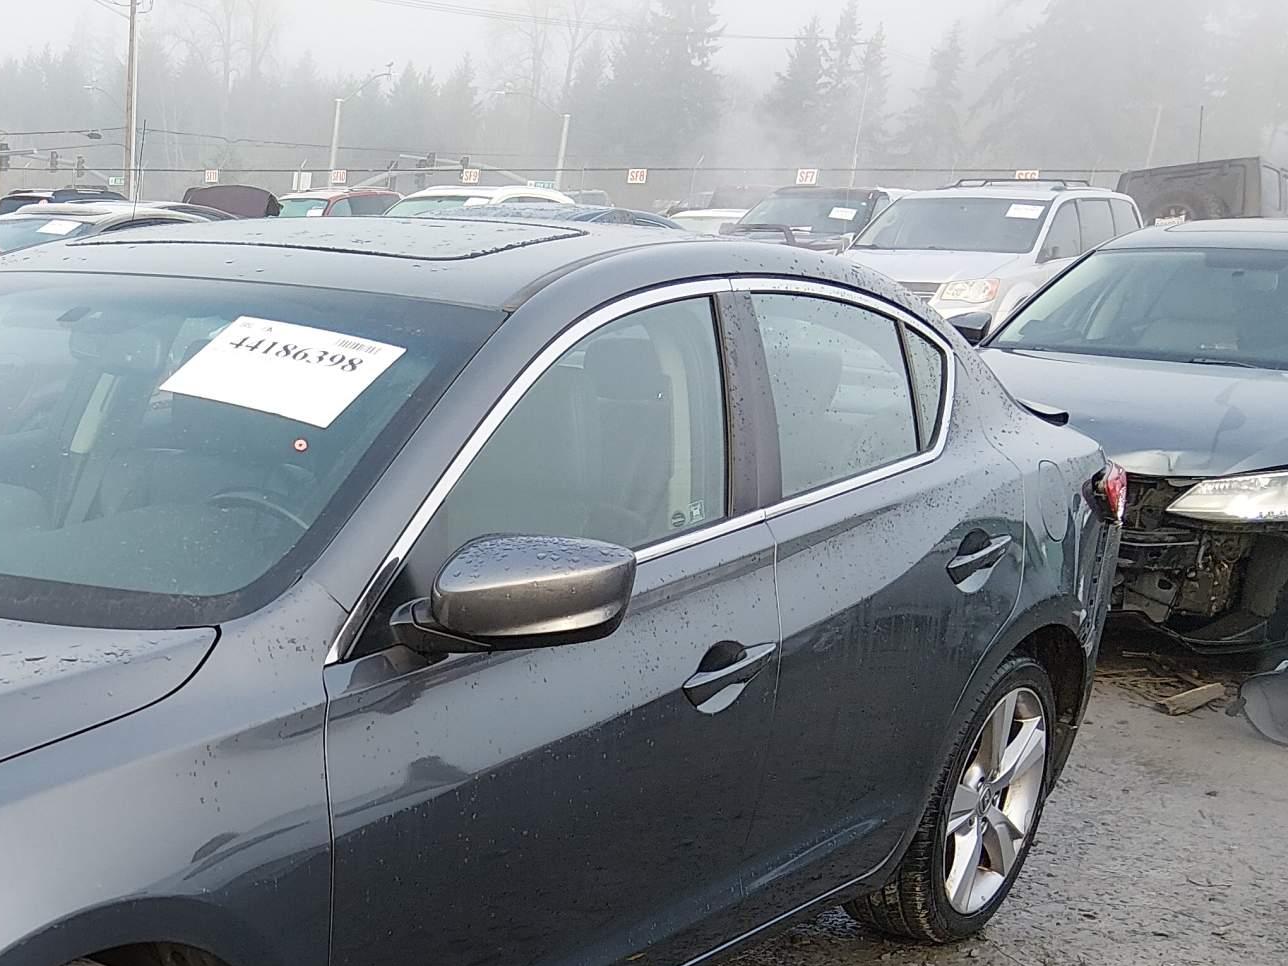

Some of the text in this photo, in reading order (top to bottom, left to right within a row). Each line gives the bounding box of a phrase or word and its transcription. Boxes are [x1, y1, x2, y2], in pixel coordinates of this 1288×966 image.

[464, 170, 478, 181] SF9
[629, 170, 645, 182] SF8
[798, 170, 815, 183] SF7
[229, 335, 364, 373] 44186398
